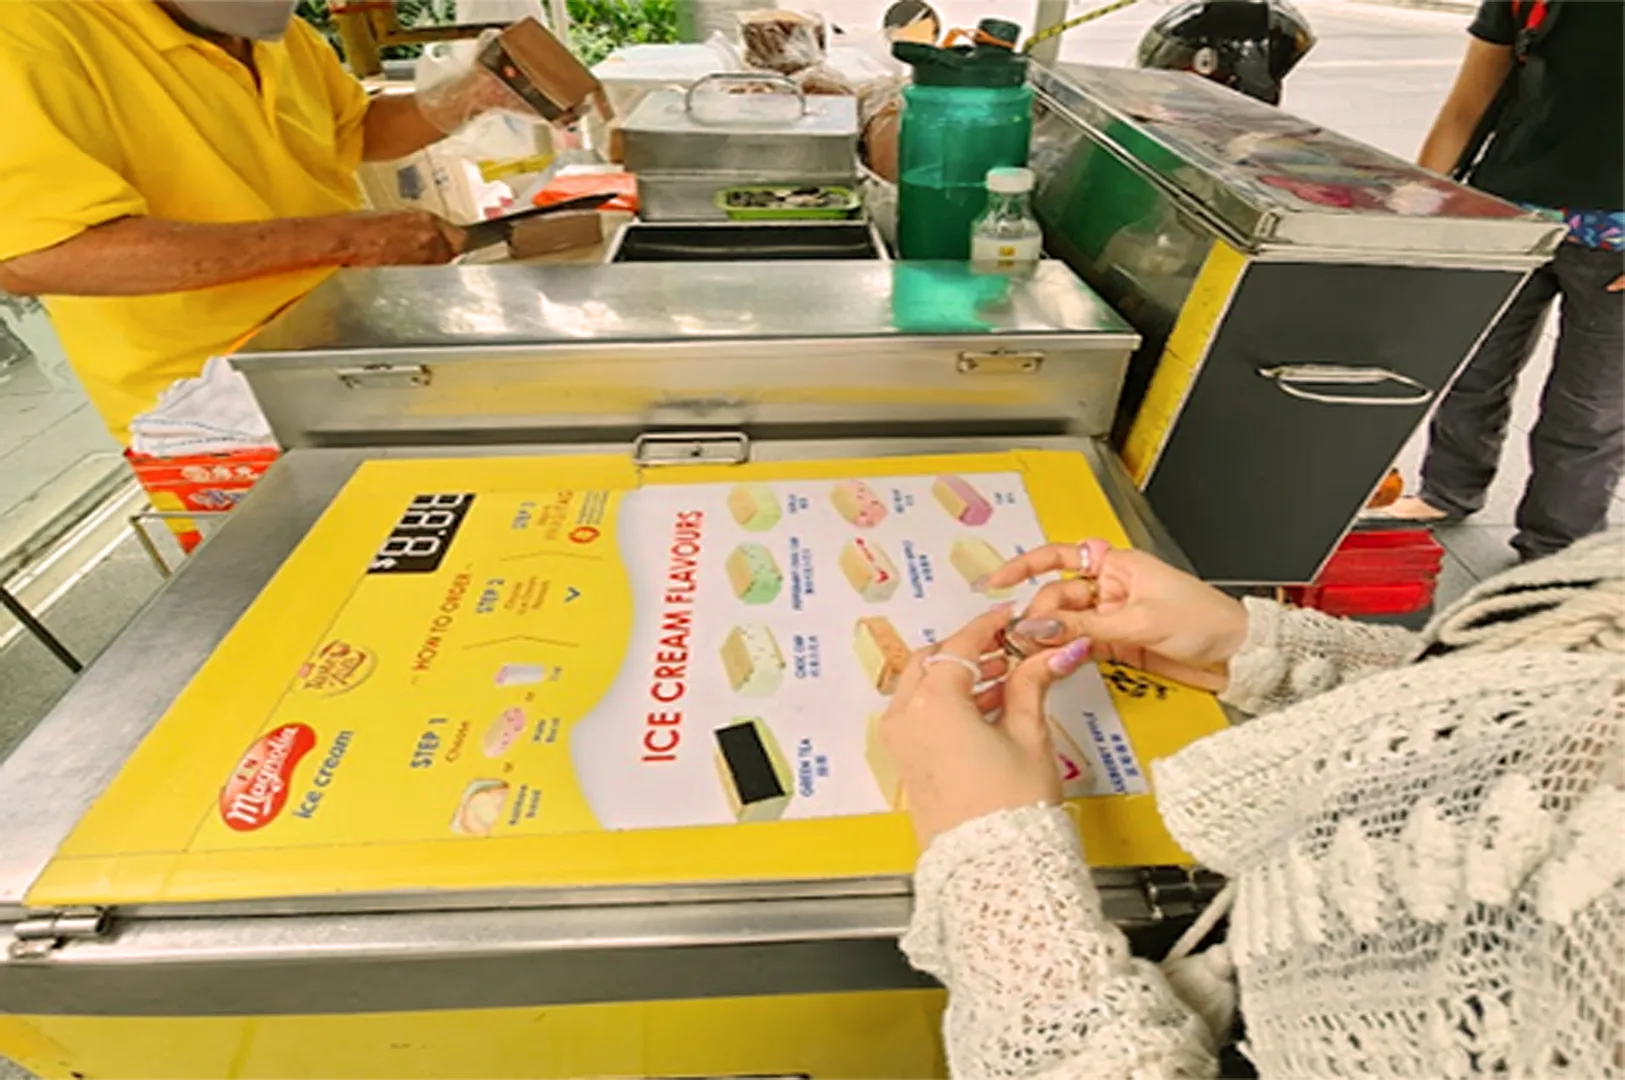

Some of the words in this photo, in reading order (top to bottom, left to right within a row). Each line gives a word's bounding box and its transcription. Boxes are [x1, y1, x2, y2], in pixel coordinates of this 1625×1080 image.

[665, 510, 704, 606] FLAVOURS
[440, 572, 471, 612] ORDER
[430, 614, 453, 633] TO
[413, 636, 442, 673] HOW
[651, 612, 693, 703] CREAM
[410, 730, 441, 769] STEP
[428, 717, 448, 726] 1
[641, 712, 681, 762] ICE
[226, 727, 298, 824] Magnolia
[292, 786, 322, 819] ice
[313, 730, 353, 787] cream
